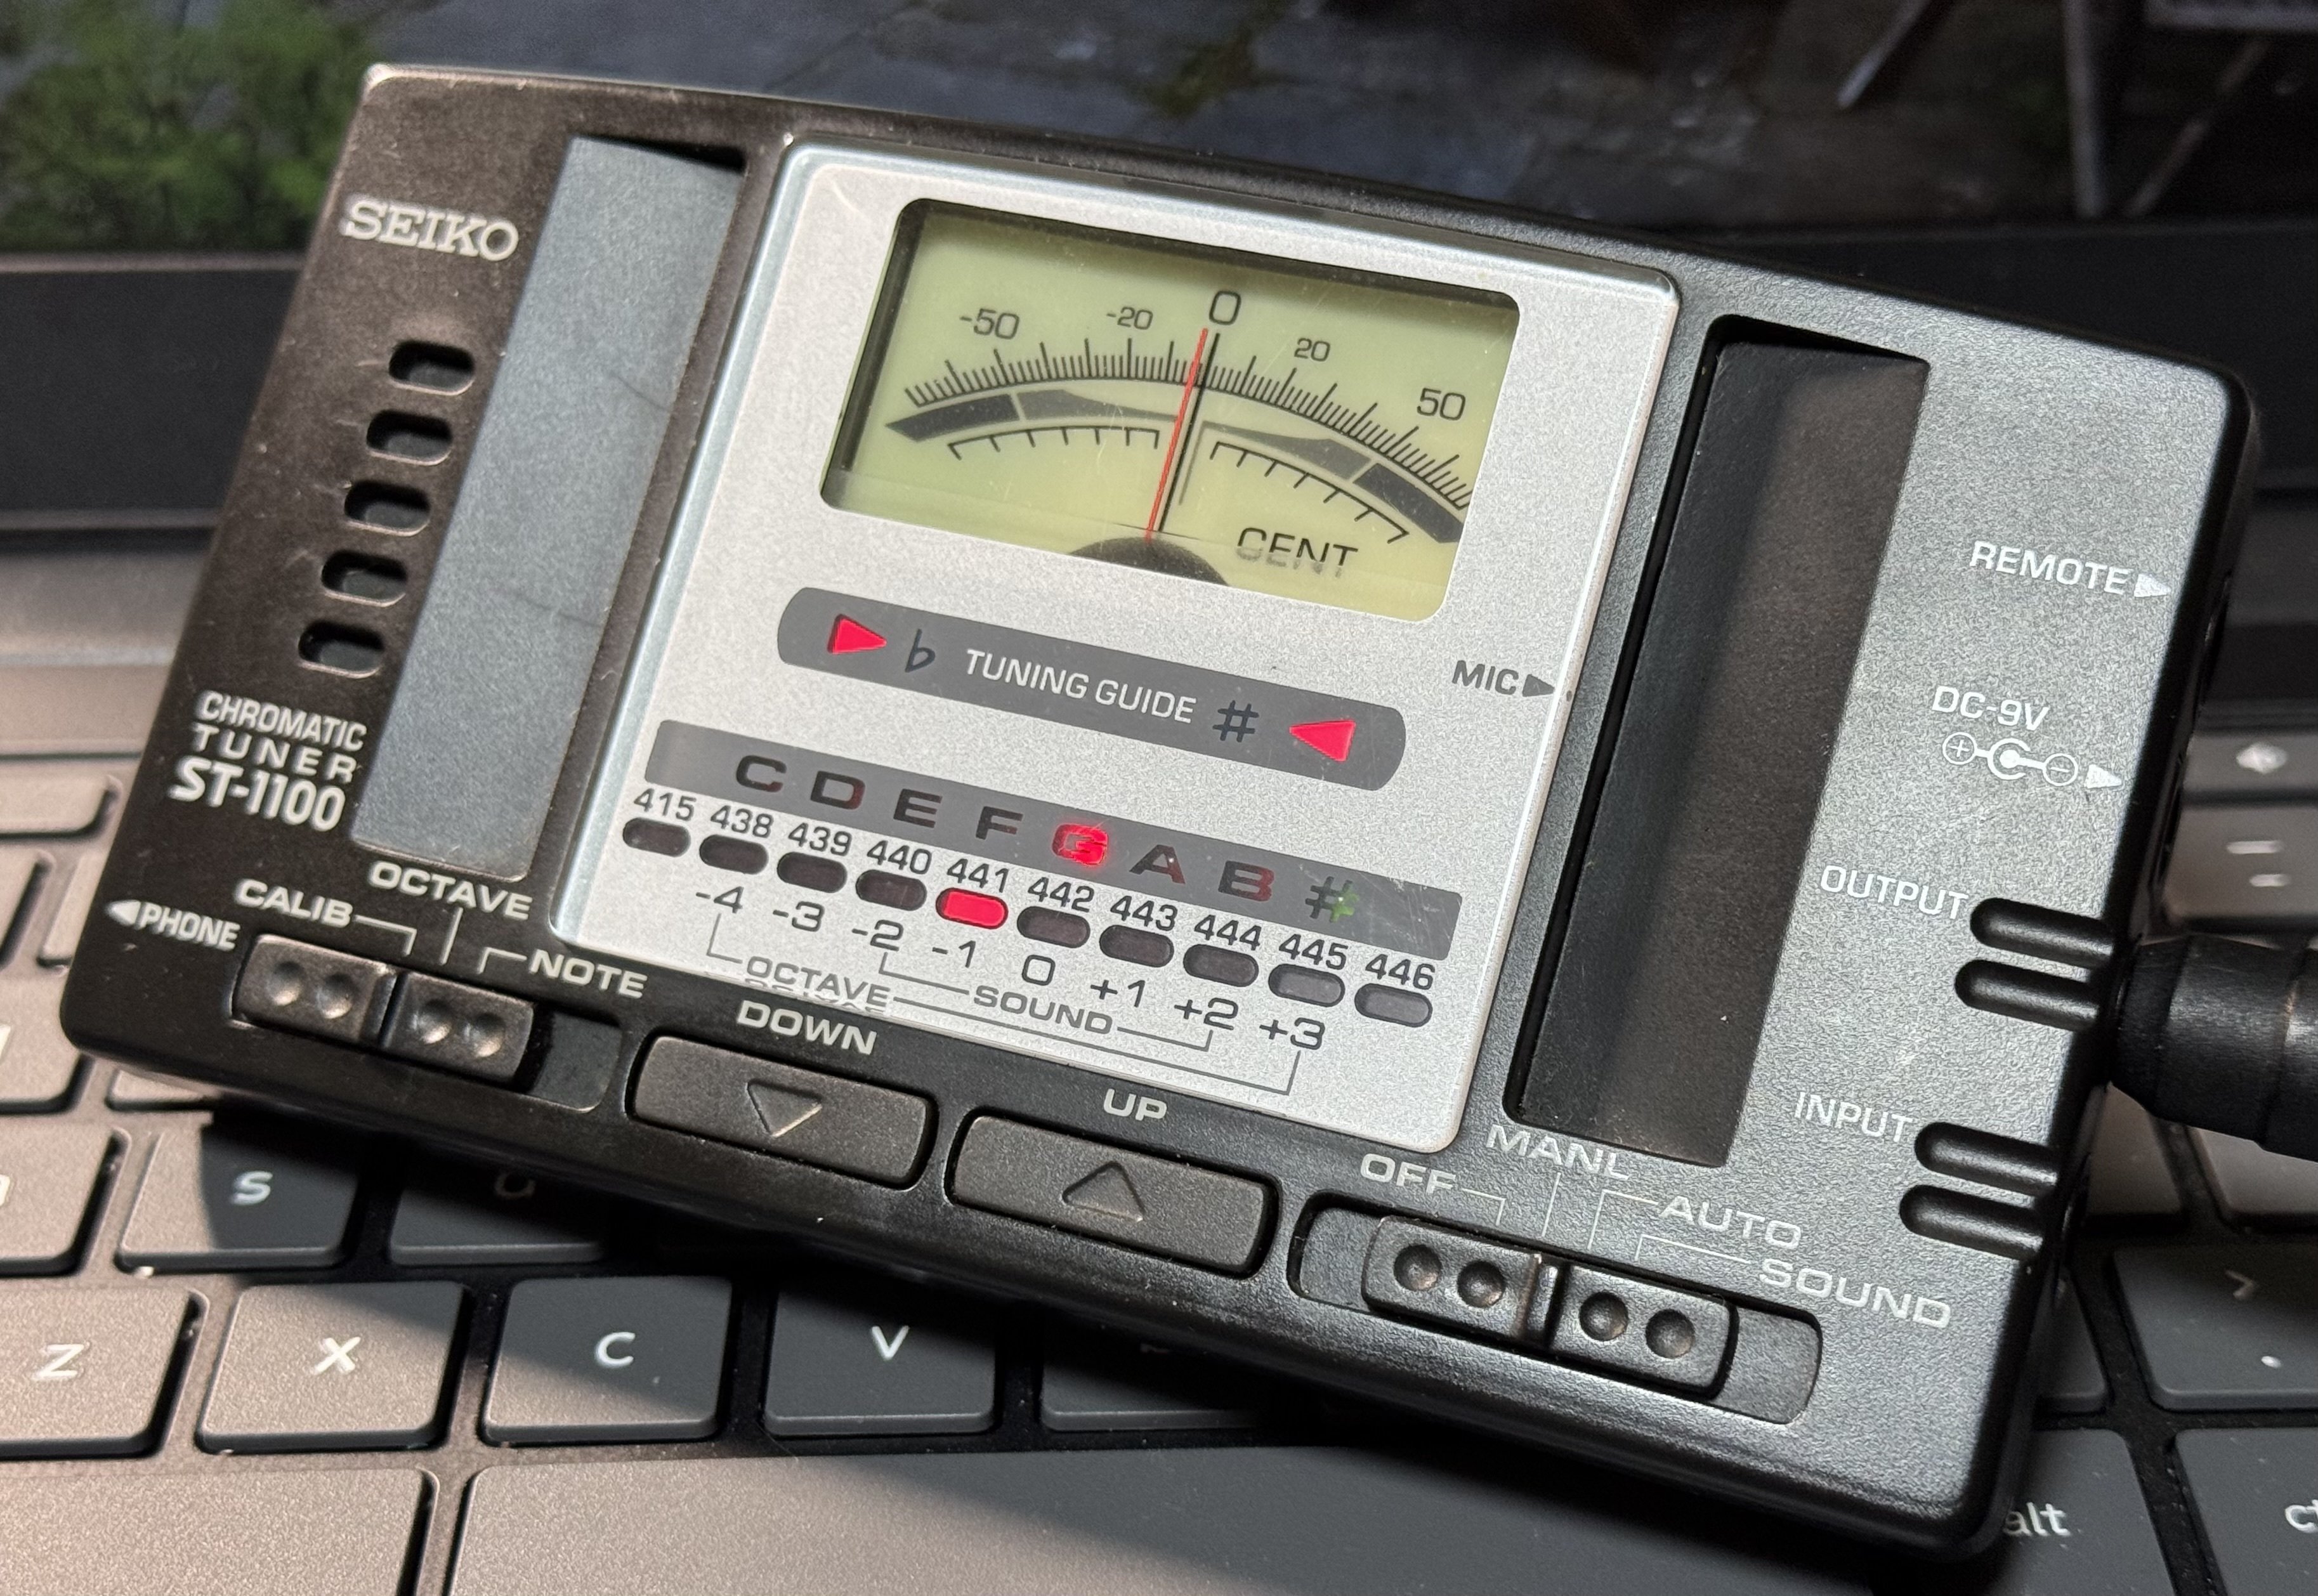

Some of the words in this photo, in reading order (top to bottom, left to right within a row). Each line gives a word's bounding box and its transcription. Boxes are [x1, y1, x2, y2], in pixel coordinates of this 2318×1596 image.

[343, 198, 518, 261] SEIKO
[960, 309, 1019, 341] -50
[1106, 306, 1153, 330] -20
[1209, 289, 1240, 325] 0
[1293, 339, 1331, 363] 20
[1415, 388, 1466, 422] 50
[1237, 527, 1359, 575] CENT
[1968, 540, 2133, 596] REMOTE
[966, 648, 1087, 700] TUNING
[1096, 678, 1198, 724] GUIDE
[1453, 659, 1519, 697] MIC
[198, 690, 367, 752] CHROMATIC
[1931, 685, 2050, 732] DC-9V
[190, 723, 362, 784] TUNER
[168, 756, 348, 832] ST-1100
[736, 755, 787, 792] C
[809, 771, 865, 810] D
[893, 788, 943, 828] E
[975, 806, 1023, 841] F
[1051, 823, 1109, 867] G
[1129, 844, 1186, 885] A
[1218, 860, 1274, 902] B
[233, 879, 354, 929] CALIB
[368, 860, 534, 922] OCTAVE
[634, 788, 696, 821] 415
[710, 804, 775, 839] 438
[788, 823, 852, 857] 439
[867, 840, 933, 875] 440
[946, 858, 1010, 894] 441
[1028, 877, 1096, 913] 442
[1110, 896, 1179, 932] 443
[1194, 914, 1262, 951] 444
[1278, 934, 1347, 971] 445
[1365, 953, 1436, 991] 446
[1820, 865, 1969, 920] OUTPUT
[140, 901, 241, 952] PHONE
[530, 953, 648, 998] NOTE
[695, 886, 745, 914] -4
[772, 901, 826, 932] -3
[851, 920, 904, 952] -2
[931, 940, 978, 969] -1
[1021, 954, 1056, 986] 0
[1090, 978, 1148, 1008] +1
[1174, 997, 1239, 1031] +2
[1259, 1017, 1326, 1051] +3
[746, 956, 891, 1009] OCTAVE
[737, 1000, 878, 1056] DOWN
[972, 984, 1113, 1035] SOUND
[1103, 1088, 1169, 1121] UP
[1793, 1092, 1916, 1144] INPUT
[1359, 1152, 1458, 1196] OFF
[1484, 1124, 1631, 1182] MANL
[232, 1170, 274, 1206] S
[1657, 1194, 1802, 1248] AUTO
[1758, 1259, 1952, 1329] SOUND
[31, 1344, 86, 1379] Z
[313, 1337, 360, 1375] X
[594, 1331, 636, 1370] C
[872, 1324, 910, 1361] V
[2002, 1501, 2071, 1536] alt
